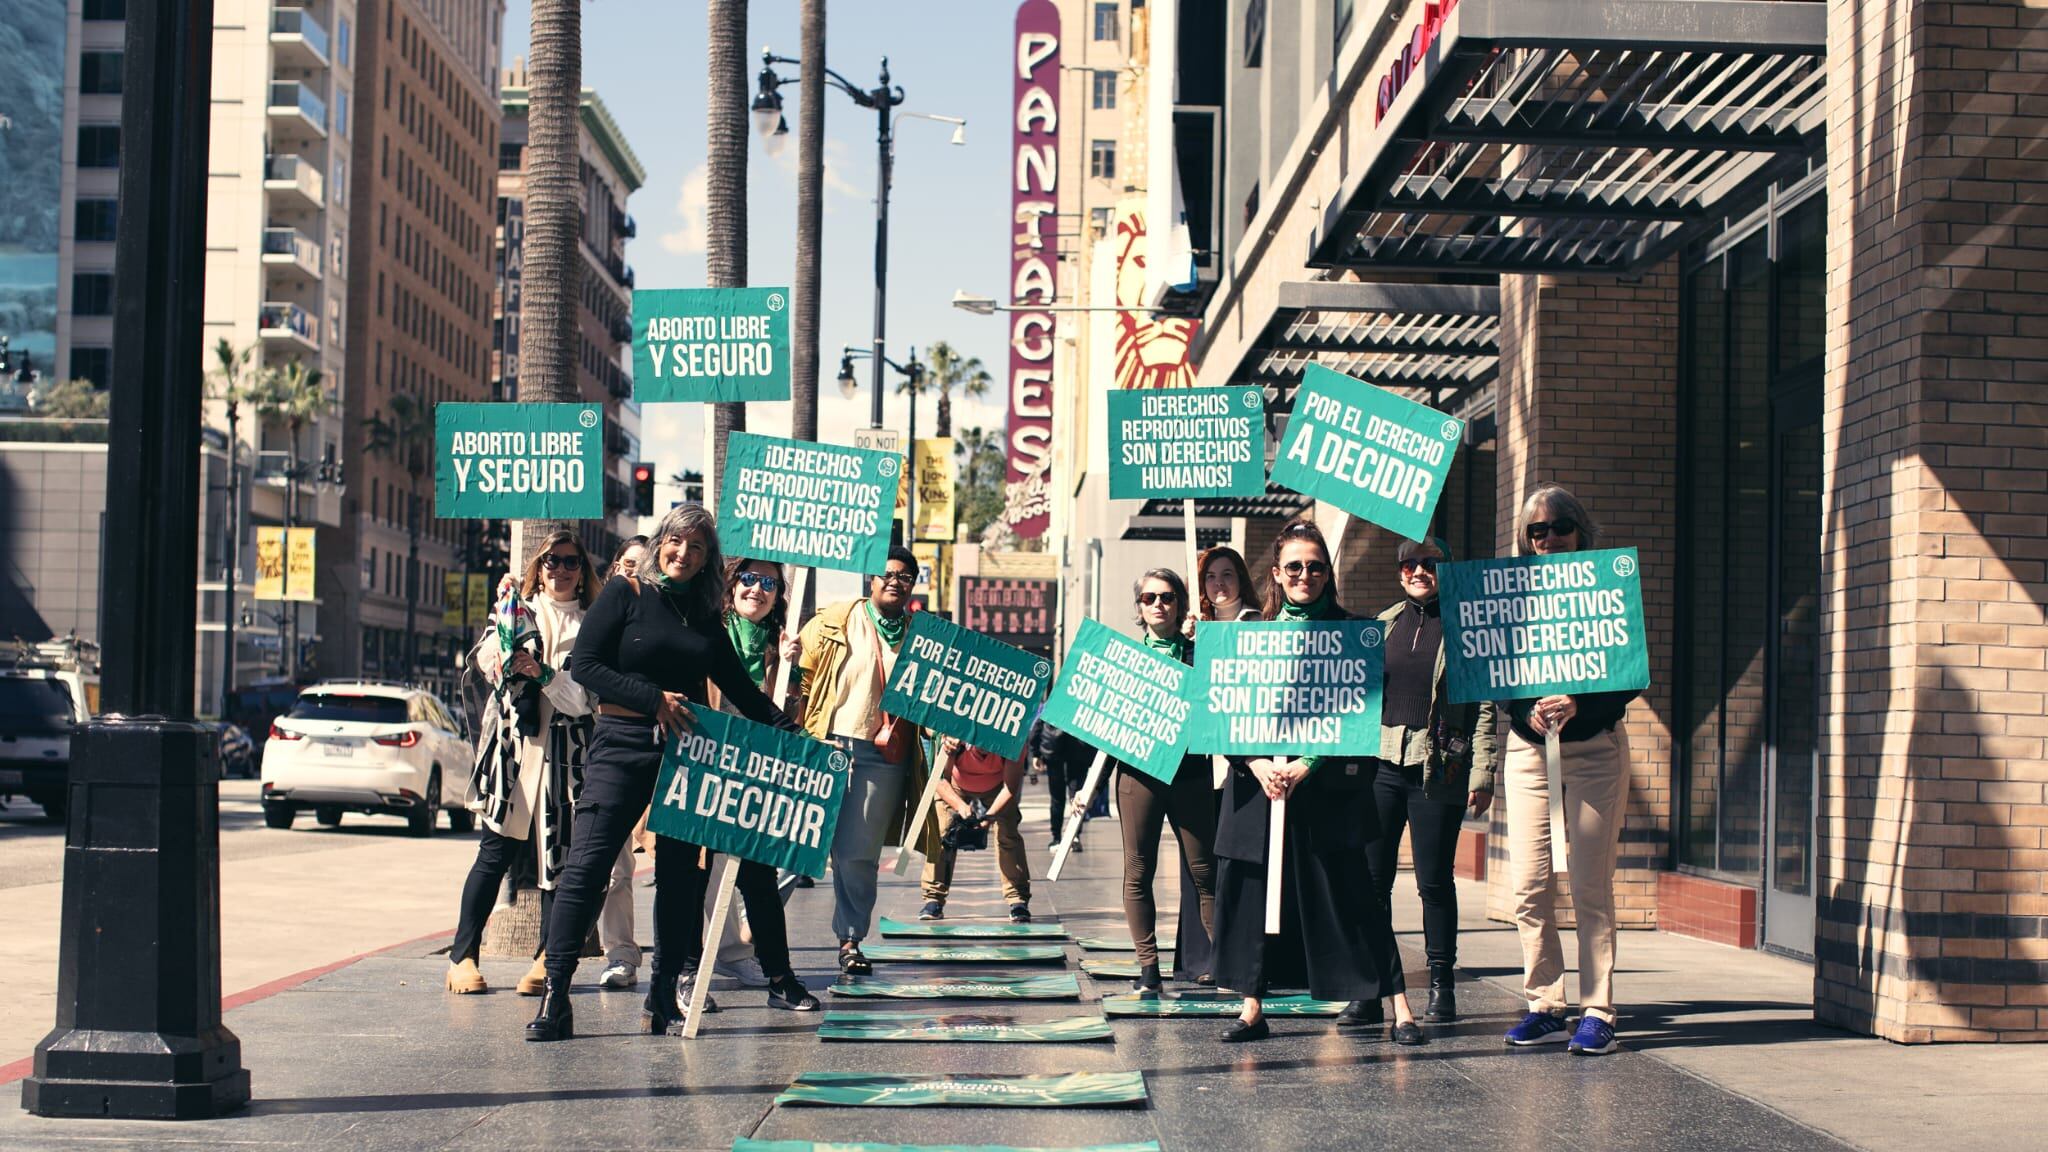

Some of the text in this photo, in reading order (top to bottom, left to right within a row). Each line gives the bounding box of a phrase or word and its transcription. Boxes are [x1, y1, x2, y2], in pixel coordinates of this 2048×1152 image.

[507, 215, 523, 335] TAFT
[647, 315, 771, 341] ABORTO LIBRE
[648, 342, 773, 377] Y SEGURO
[1142, 394, 1229, 417] ¡DERECHOS
[451, 431, 584, 456] ABORTO LIBRE
[857, 436, 896, 450] DO NOT
[1121, 417, 1250, 440] REPRODUCTIVOS
[1302, 391, 1445, 467] POR EL DERECHO
[764, 444, 864, 480] ¡DERECHOS
[1122, 440, 1251, 465] SON DERECHOS
[1286, 422, 1434, 513] A DECIDIR
[453, 458, 585, 493] Y SEGURO
[737, 468, 882, 509] REPRODUCTIVOS
[1142, 465, 1233, 489] HUMANOS!
[734, 493, 878, 536] SON DERECHOS
[751, 523, 855, 561] HUMANOS!
[1483, 560, 1596, 596] ¡DERECHOS
[1459, 588, 1625, 628] REPRODUCTIVOS
[1236, 630, 1343, 656] ¡DERECHOS
[1461, 617, 1629, 659] SON DERECHOS
[909, 634, 1037, 700] POR EL DERECHO
[1103, 637, 1183, 692] ¡DERECHOS
[1210, 658, 1367, 684] REPRODUCTIVOS
[1488, 651, 1608, 688] HUMANOS!
[894, 660, 1027, 737] A DECIDIR
[1076, 651, 1191, 723] REPRODUCTIVOS
[1207, 686, 1367, 714] SON DERECHOS
[1067, 673, 1181, 746] SON DERECHOS
[1072, 703, 1156, 762] HUMANOS!
[1229, 716, 1342, 744] HUMANOS!
[675, 731, 835, 800] POR EL DERECHO
[663, 765, 827, 849] A DECIDIR
